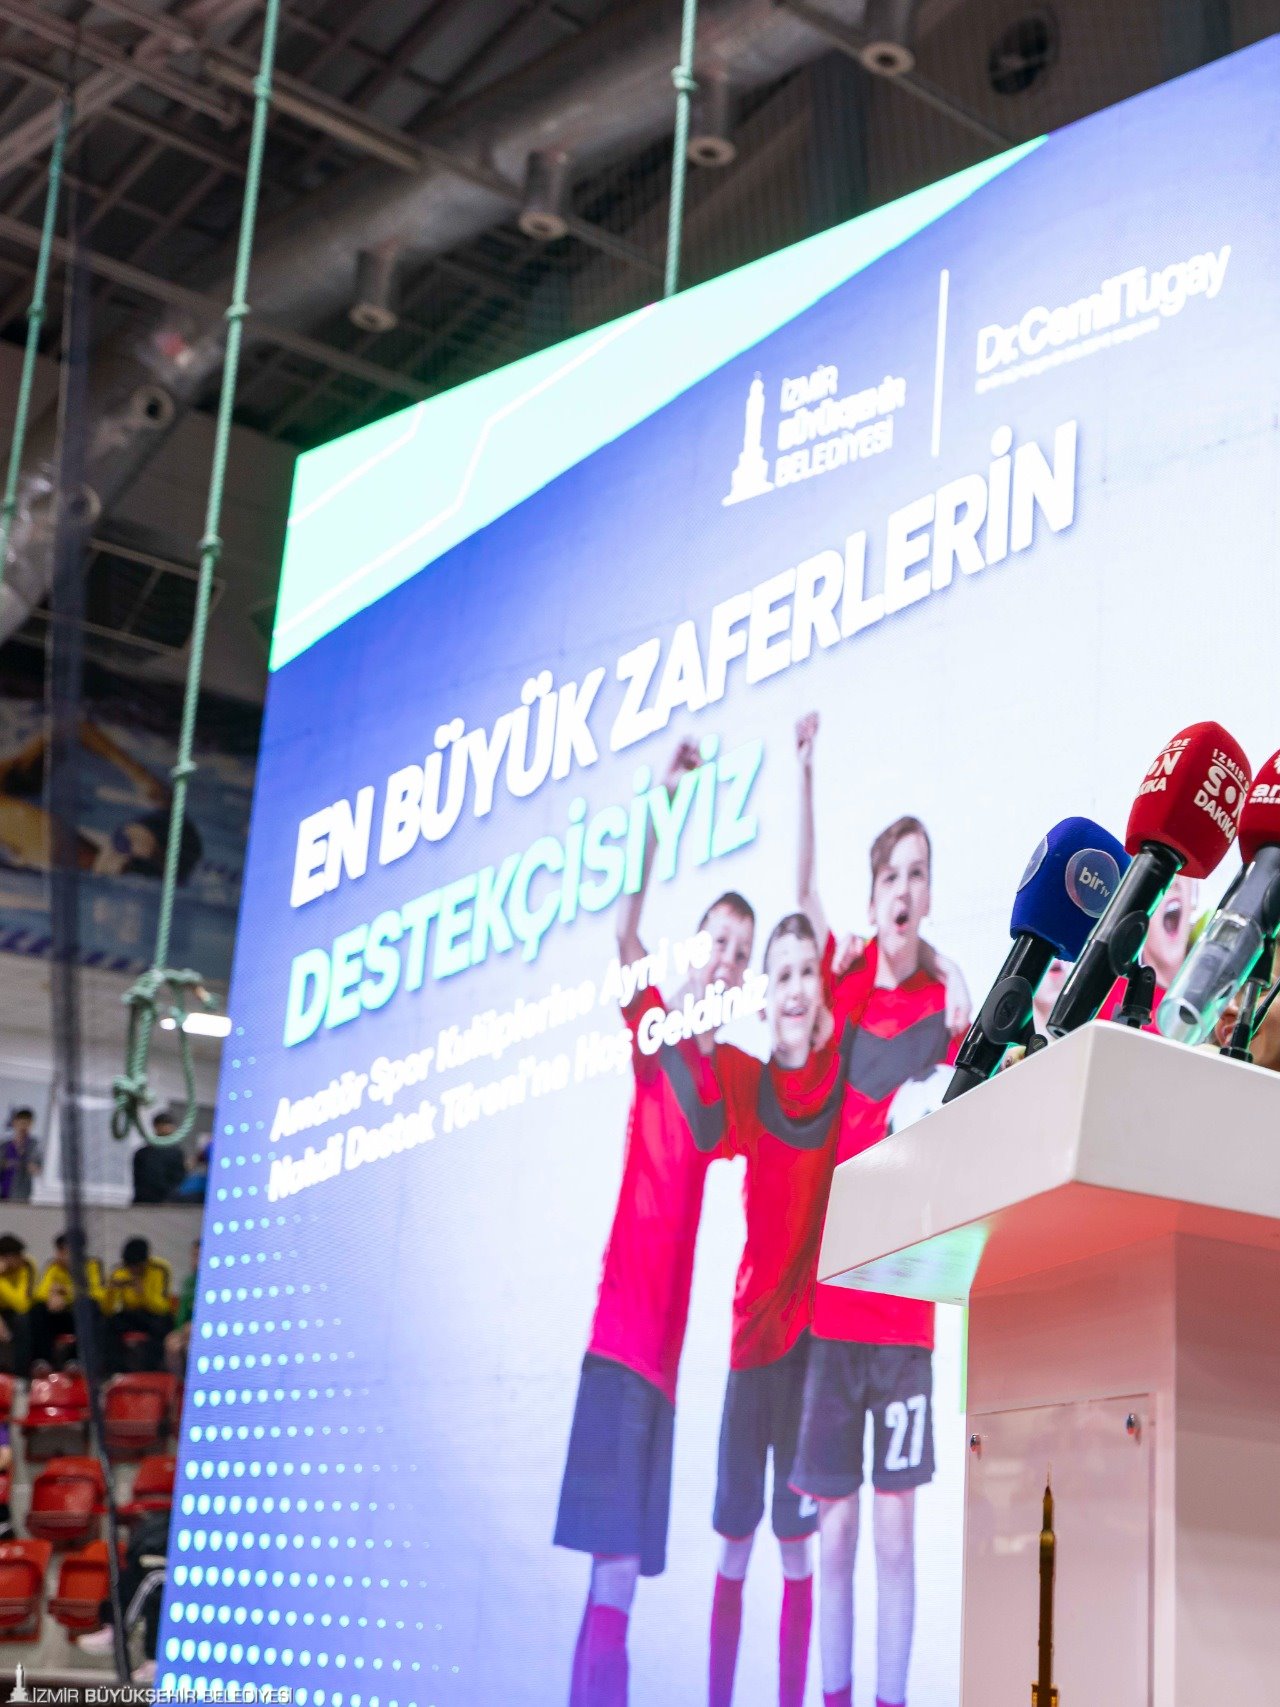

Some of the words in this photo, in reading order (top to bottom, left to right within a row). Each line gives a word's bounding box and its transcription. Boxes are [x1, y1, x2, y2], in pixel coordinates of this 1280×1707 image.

[289, 784, 374, 907] EN
[378, 668, 605, 866] BÜYÜK
[610, 420, 1080, 753] ZAFERLERİN
[282, 734, 766, 1048] DESTEKÇİSİYİZ
[368, 1047, 435, 1105] Spor
[673, 930, 712, 974] ve
[344, 1100, 437, 1170] Destek
[884, 1394, 928, 1472] 27
